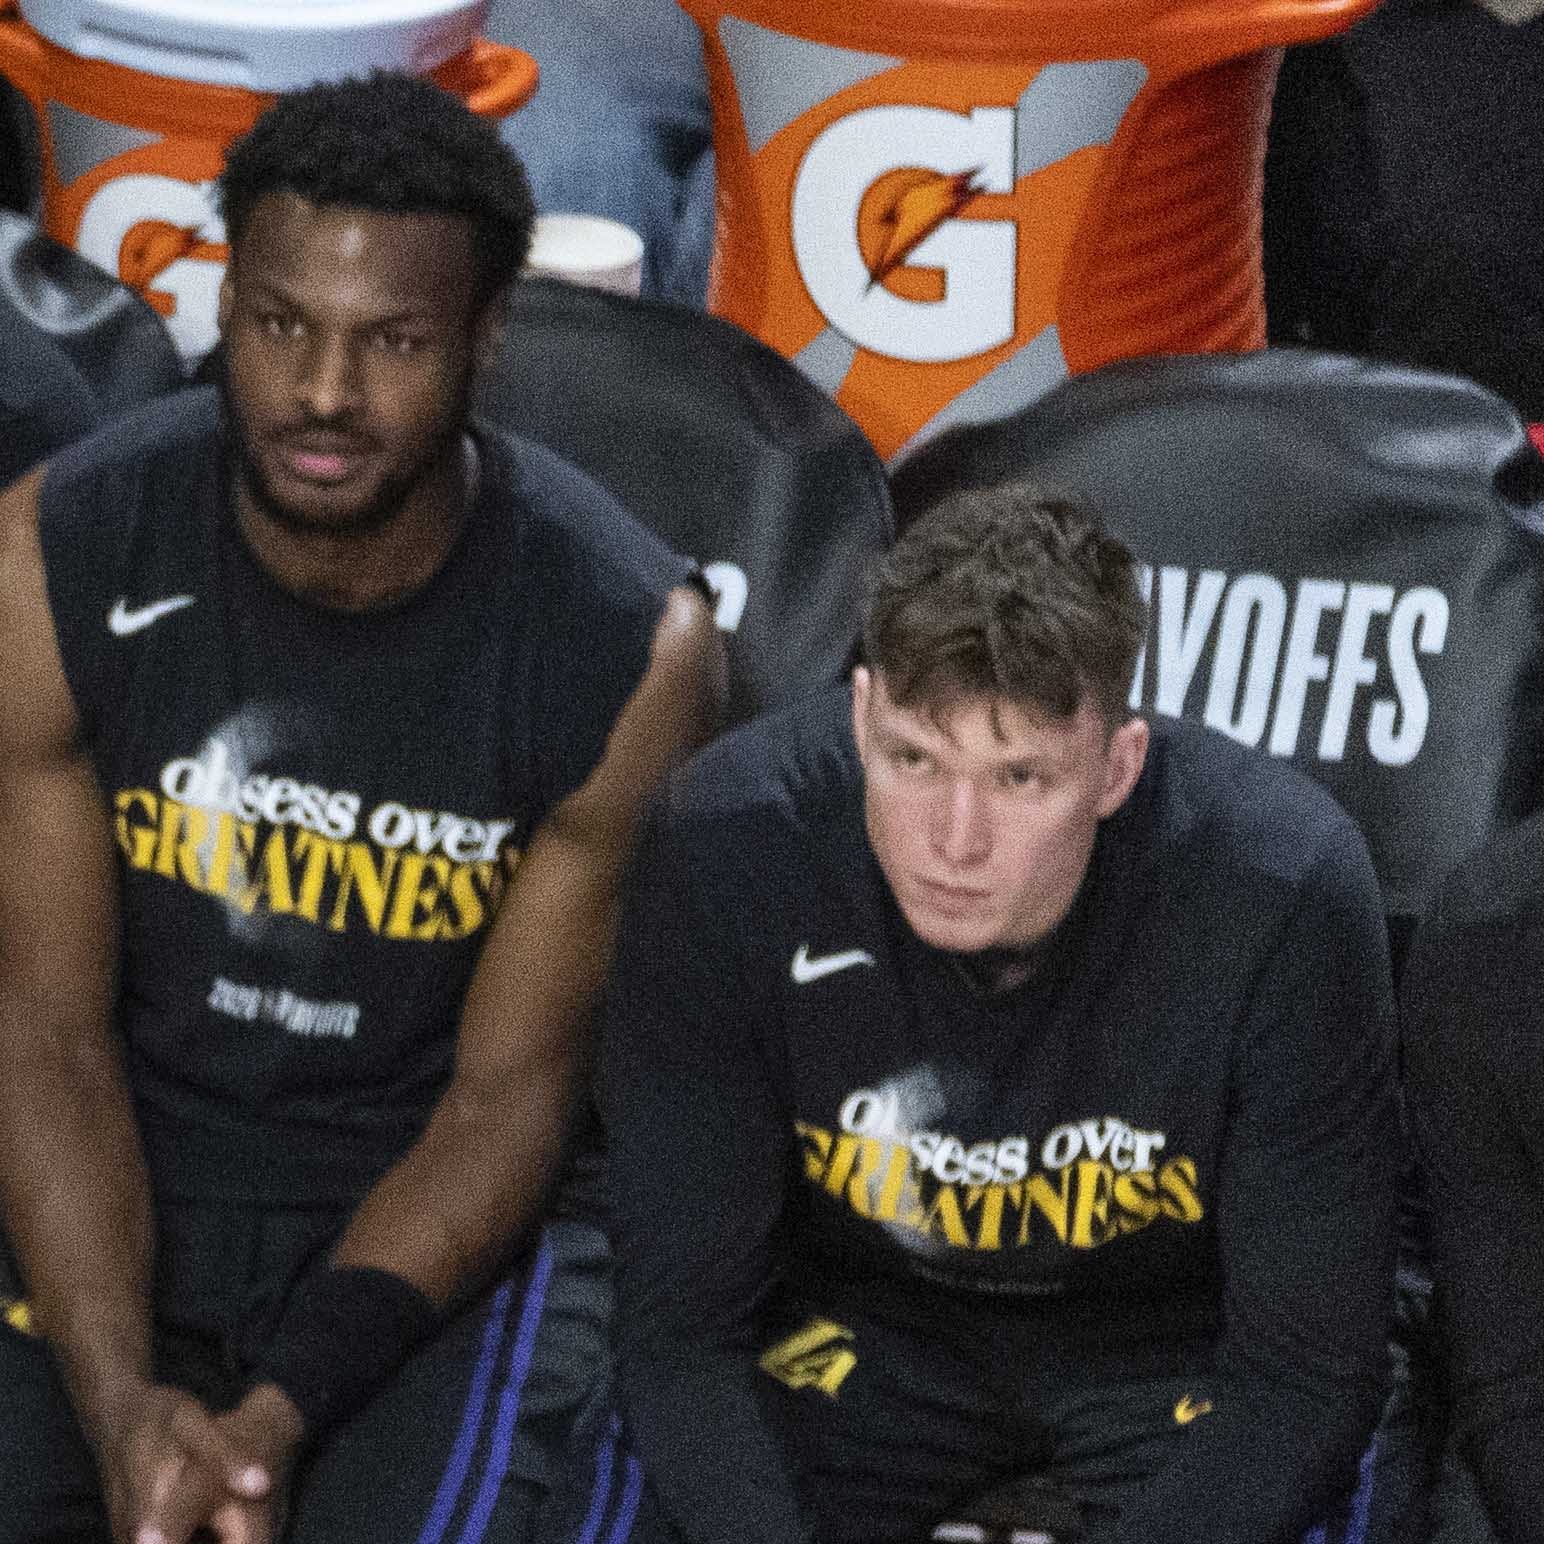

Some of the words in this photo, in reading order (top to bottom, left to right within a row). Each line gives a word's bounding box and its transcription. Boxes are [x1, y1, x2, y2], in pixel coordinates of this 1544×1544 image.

[792, 104, 1018, 364] G
[115, 785, 526, 942] GREATNES
[367, 800, 515, 862] over
[1040, 1116, 1167, 1173] over
